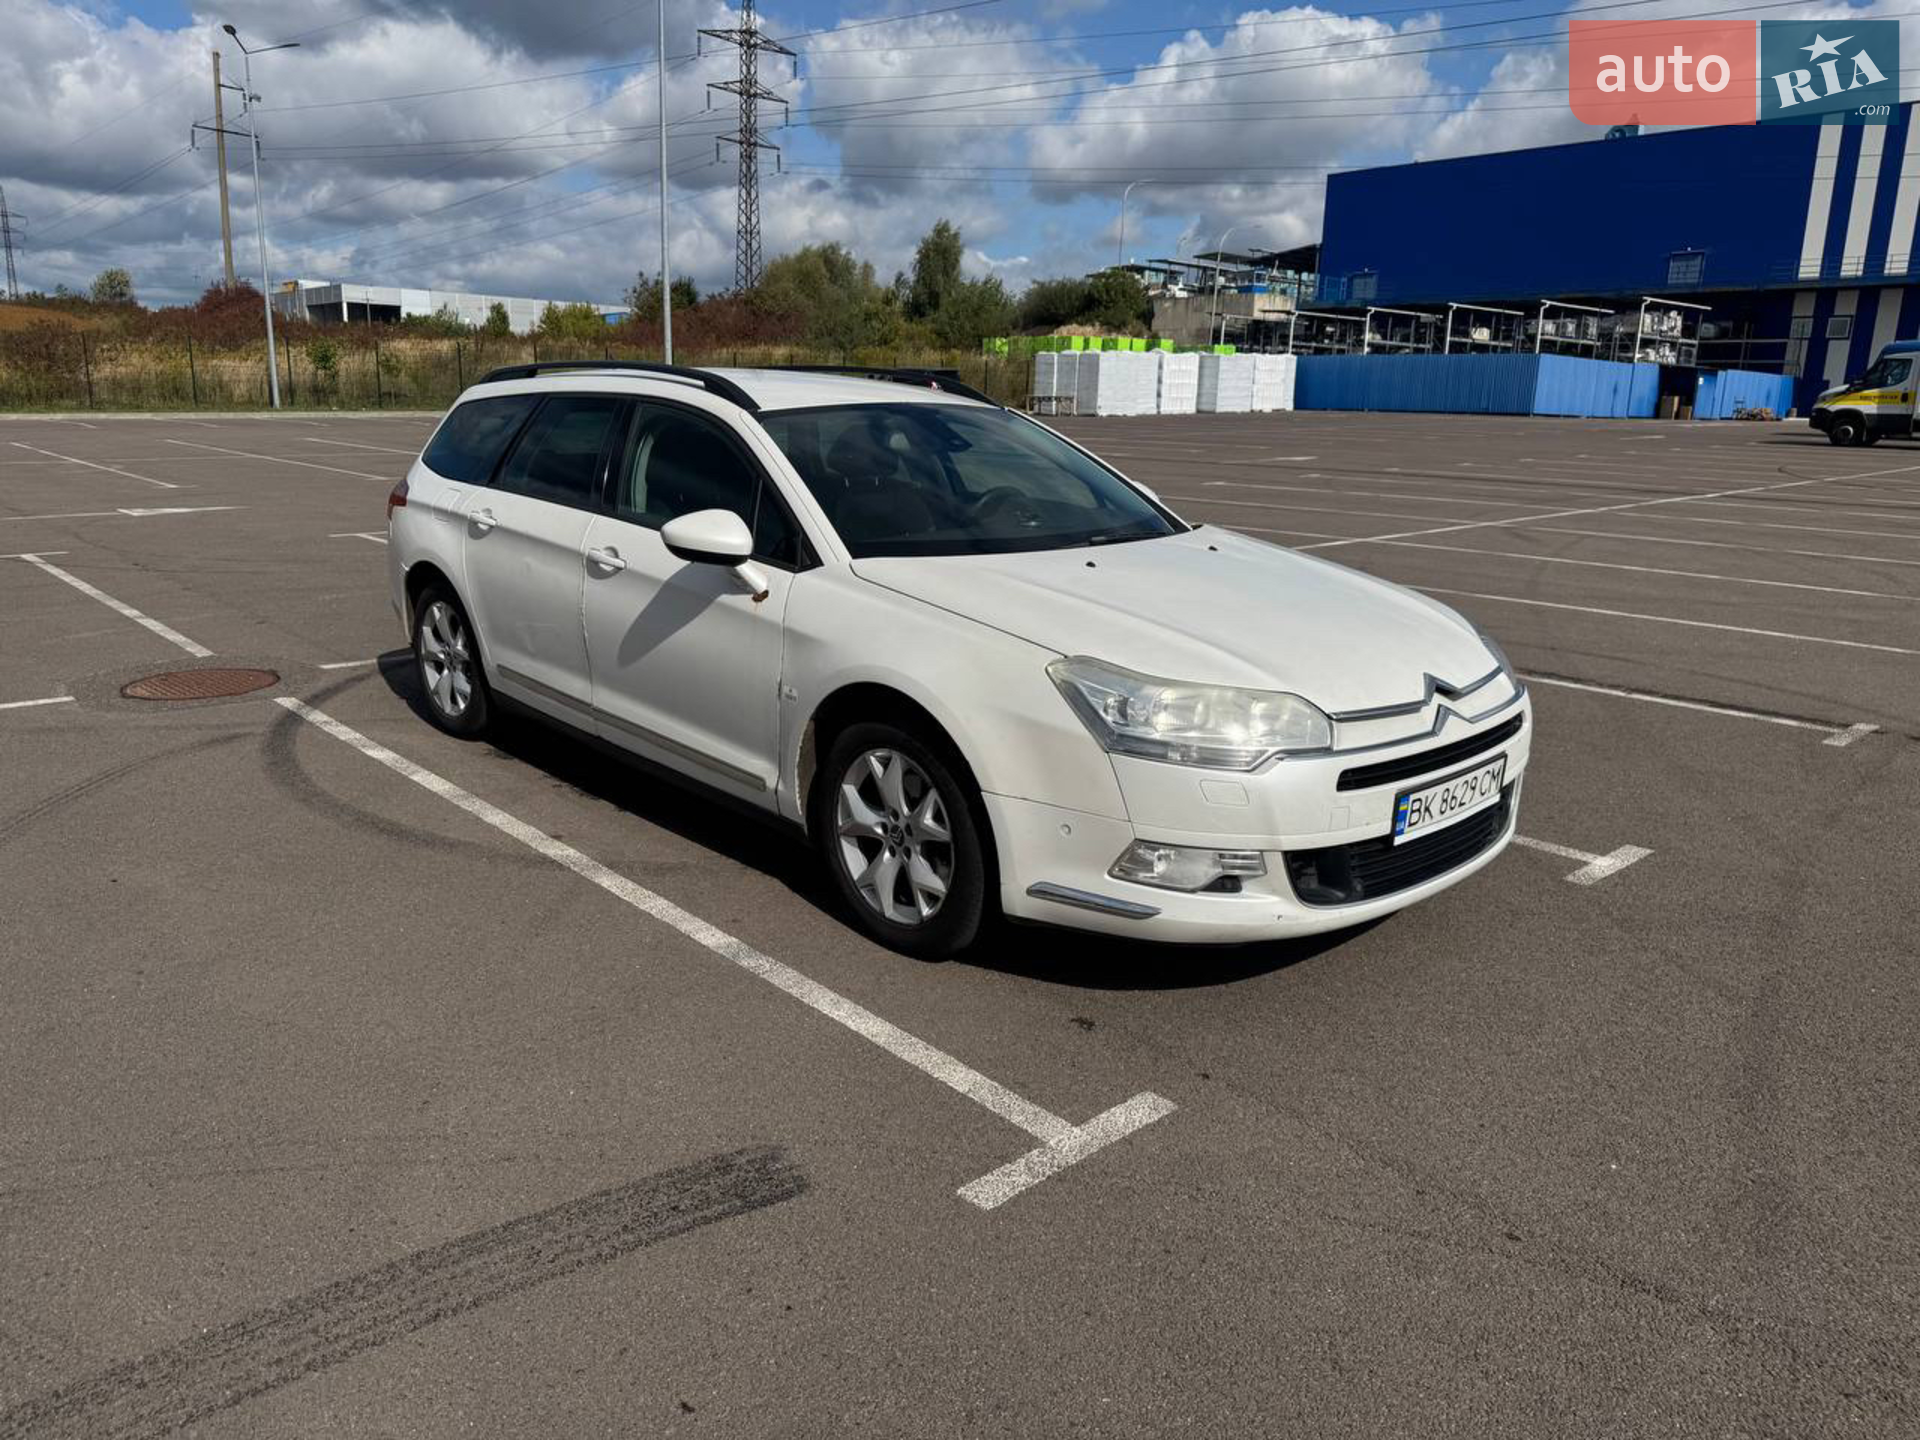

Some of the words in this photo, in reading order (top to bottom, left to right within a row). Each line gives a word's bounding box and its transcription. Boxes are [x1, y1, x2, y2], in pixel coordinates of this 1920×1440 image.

[1407, 792, 1438, 828] BK
[1439, 776, 1479, 815] 8629
[1480, 764, 1502, 796] CM
